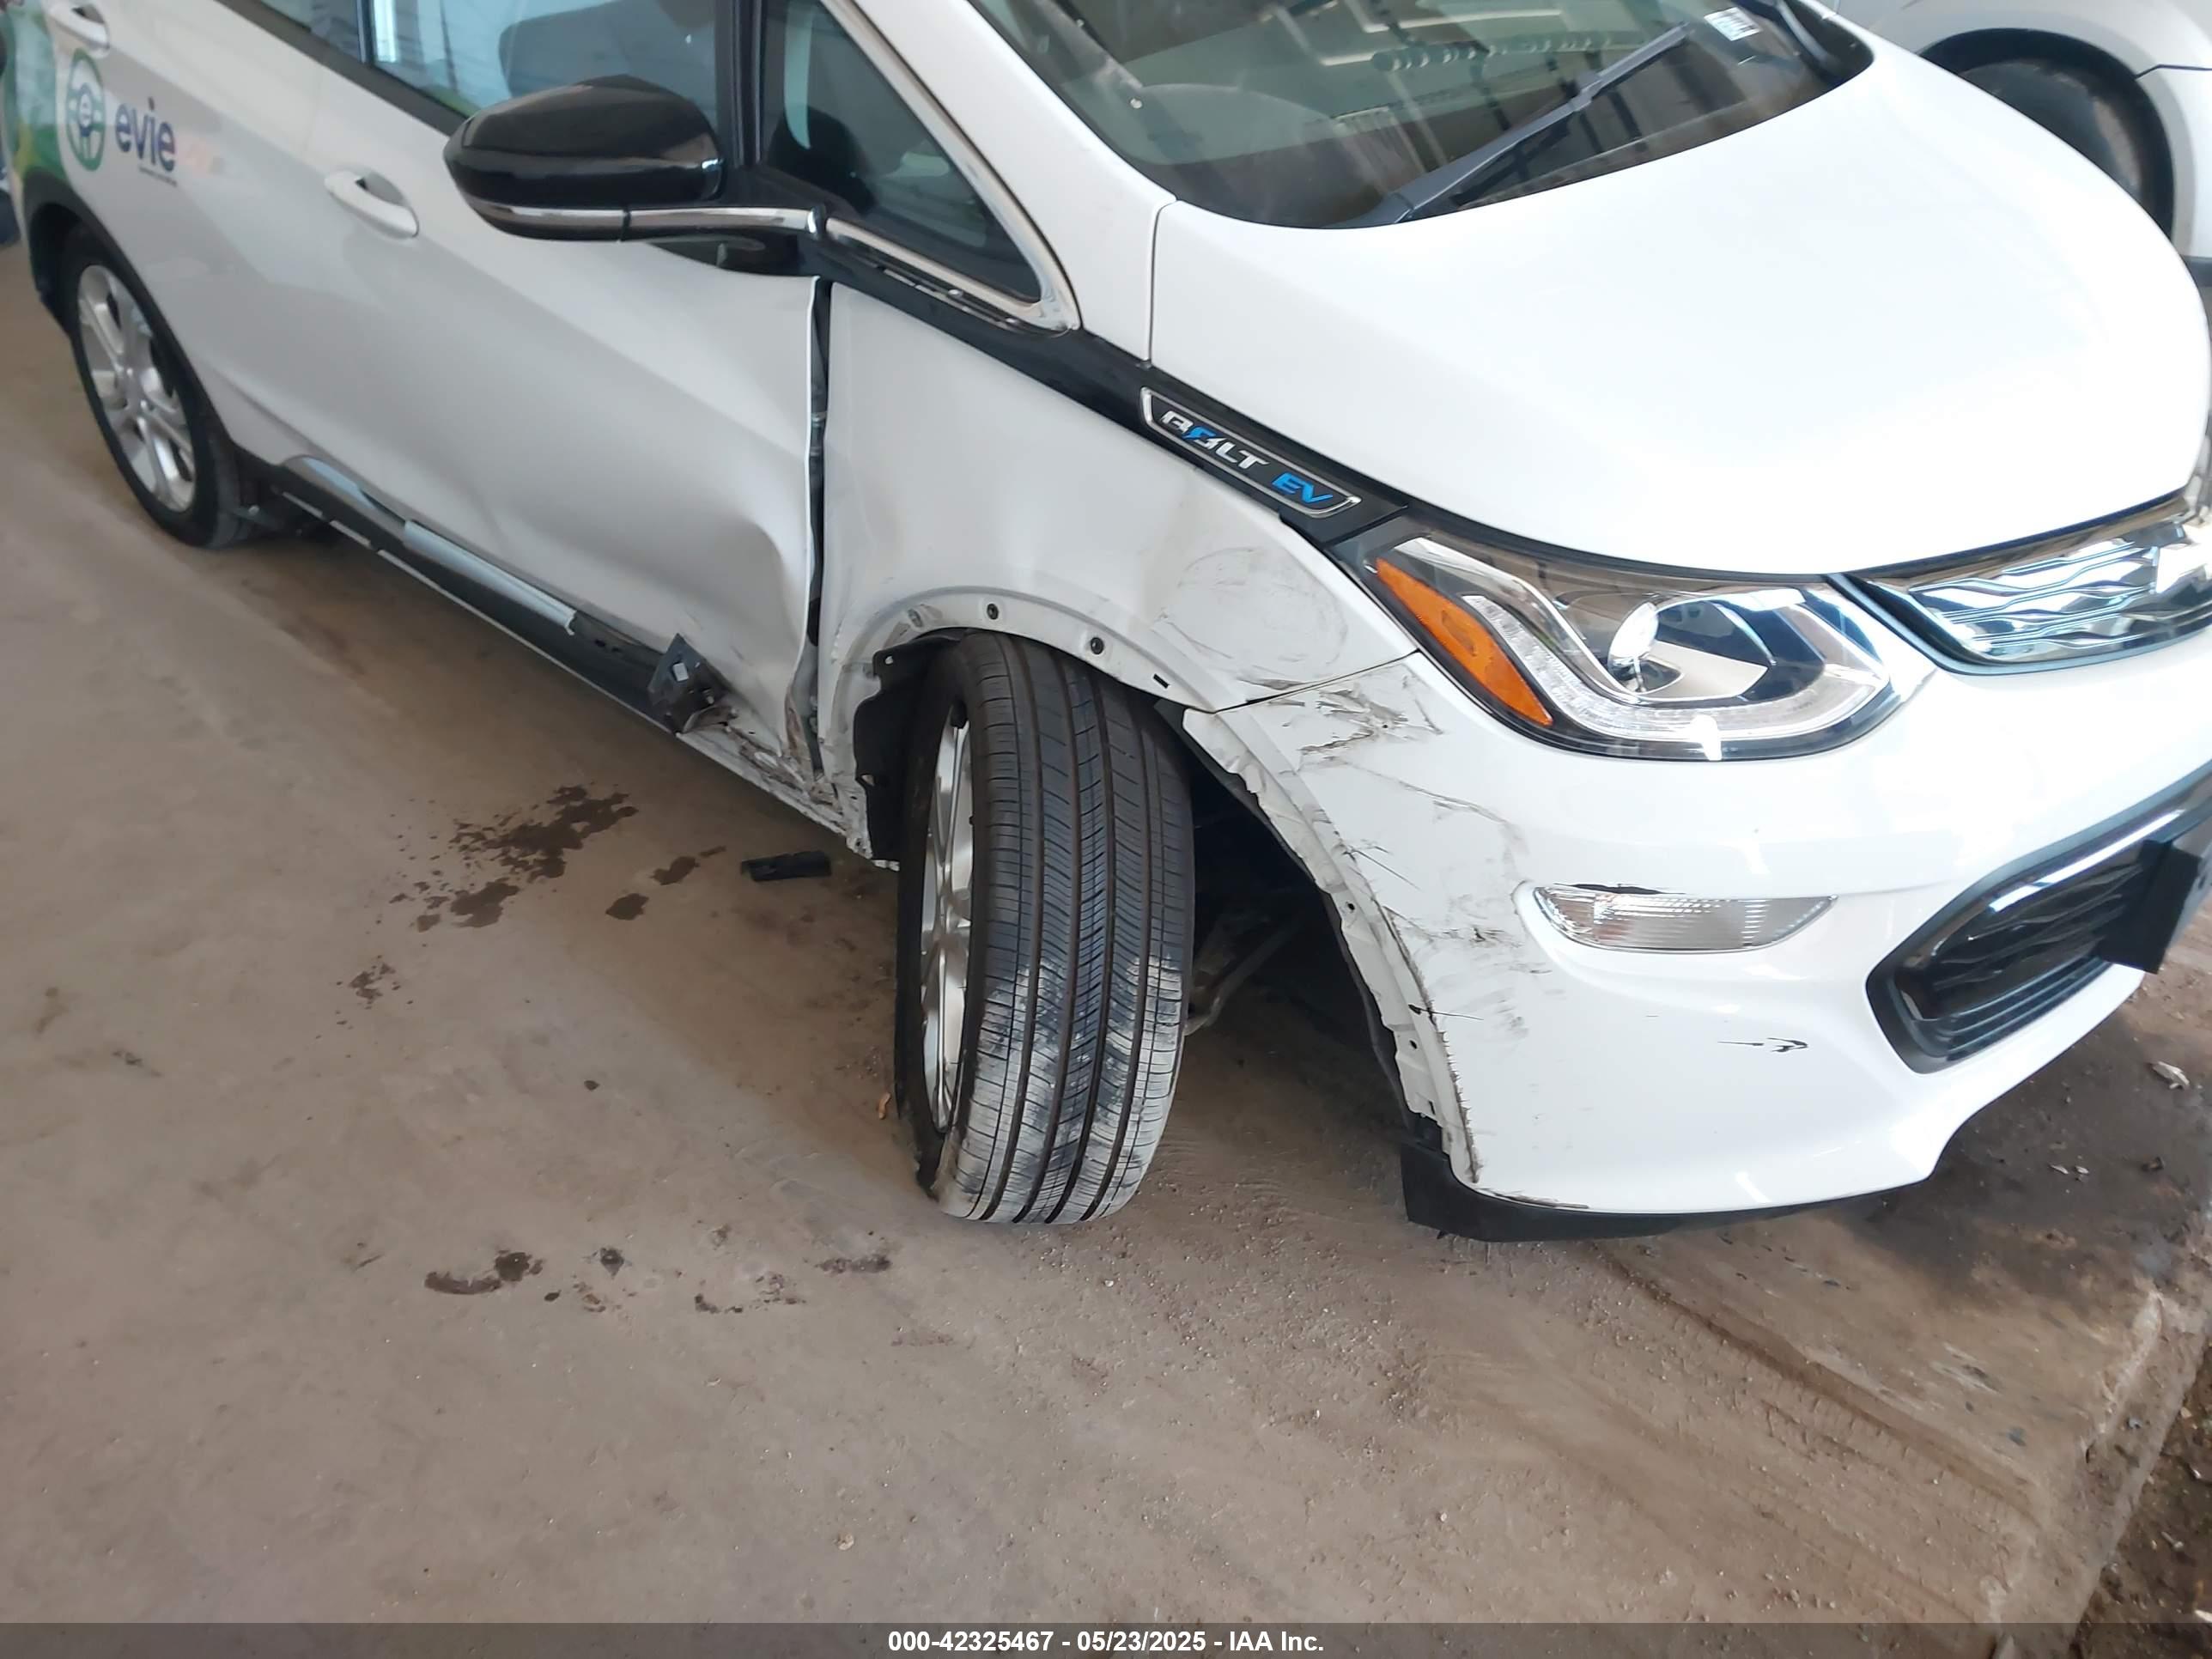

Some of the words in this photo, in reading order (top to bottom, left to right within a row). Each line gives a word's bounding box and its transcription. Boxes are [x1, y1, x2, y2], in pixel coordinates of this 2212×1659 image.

[115, 96, 176, 172] evie
[1160, 410, 1270, 470] BOLT
[1271, 472, 1334, 503] EV
